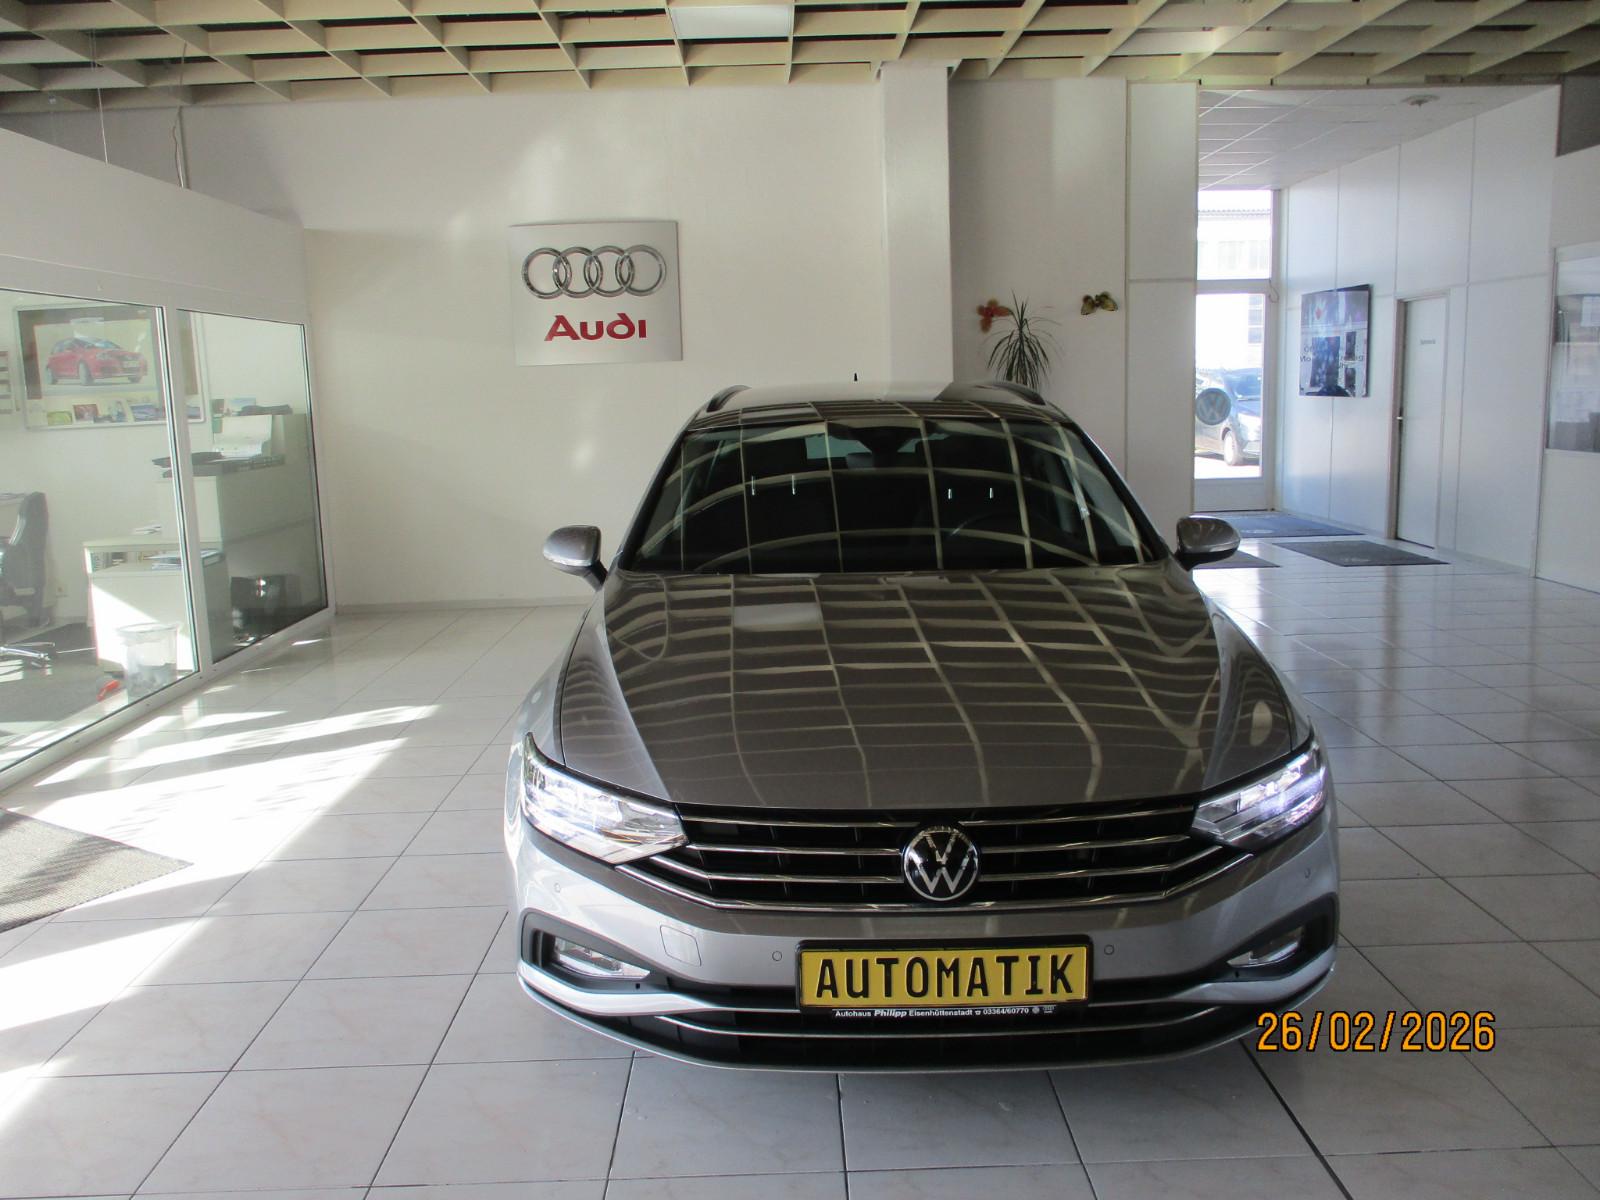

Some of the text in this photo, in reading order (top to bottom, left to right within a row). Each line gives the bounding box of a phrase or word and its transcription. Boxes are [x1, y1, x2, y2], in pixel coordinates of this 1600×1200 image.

[544, 312, 647, 341] Audi
[816, 954, 1073, 998] AUTOMATIK
[873, 1009, 907, 1018] Philipp
[908, 1008, 973, 1016] Eisenhüttenstadt
